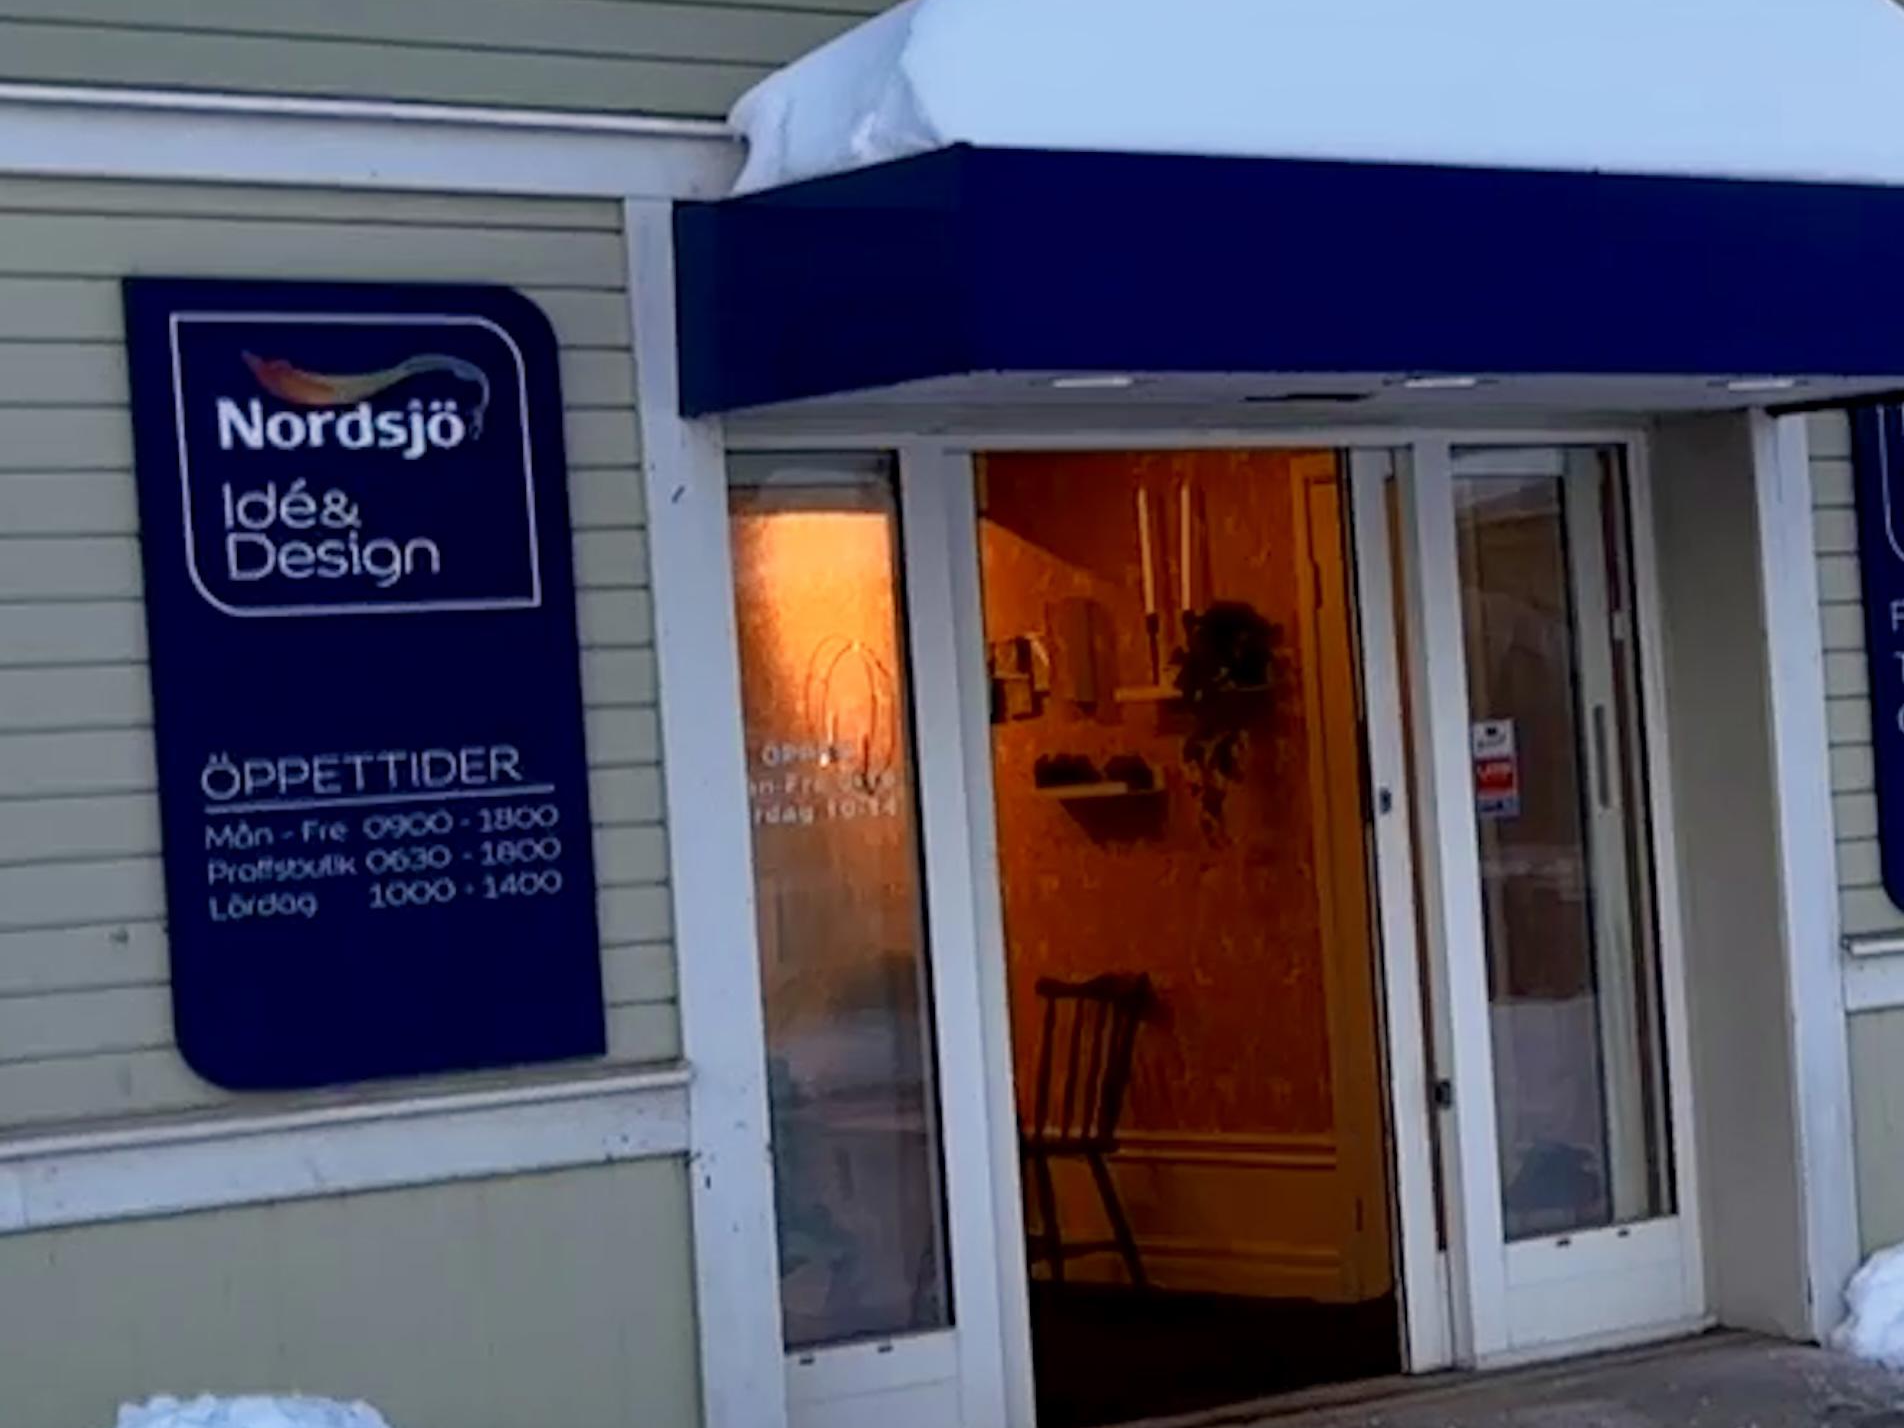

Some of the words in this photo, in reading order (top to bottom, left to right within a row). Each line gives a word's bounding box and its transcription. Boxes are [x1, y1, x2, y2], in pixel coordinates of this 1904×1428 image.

[216, 396, 466, 460] Nordsjö
[221, 478, 361, 530] Idé&
[226, 531, 441, 588] Design
[200, 745, 525, 801] ÖPPETTIDER
[205, 819, 274, 851] Mån
[302, 819, 349, 844] Fre
[362, 809, 454, 841] 0900
[478, 803, 560, 834] 1800
[365, 843, 453, 874] 0630
[480, 836, 562, 866] 1800
[369, 876, 457, 910] 1000
[482, 869, 563, 900] 1400
